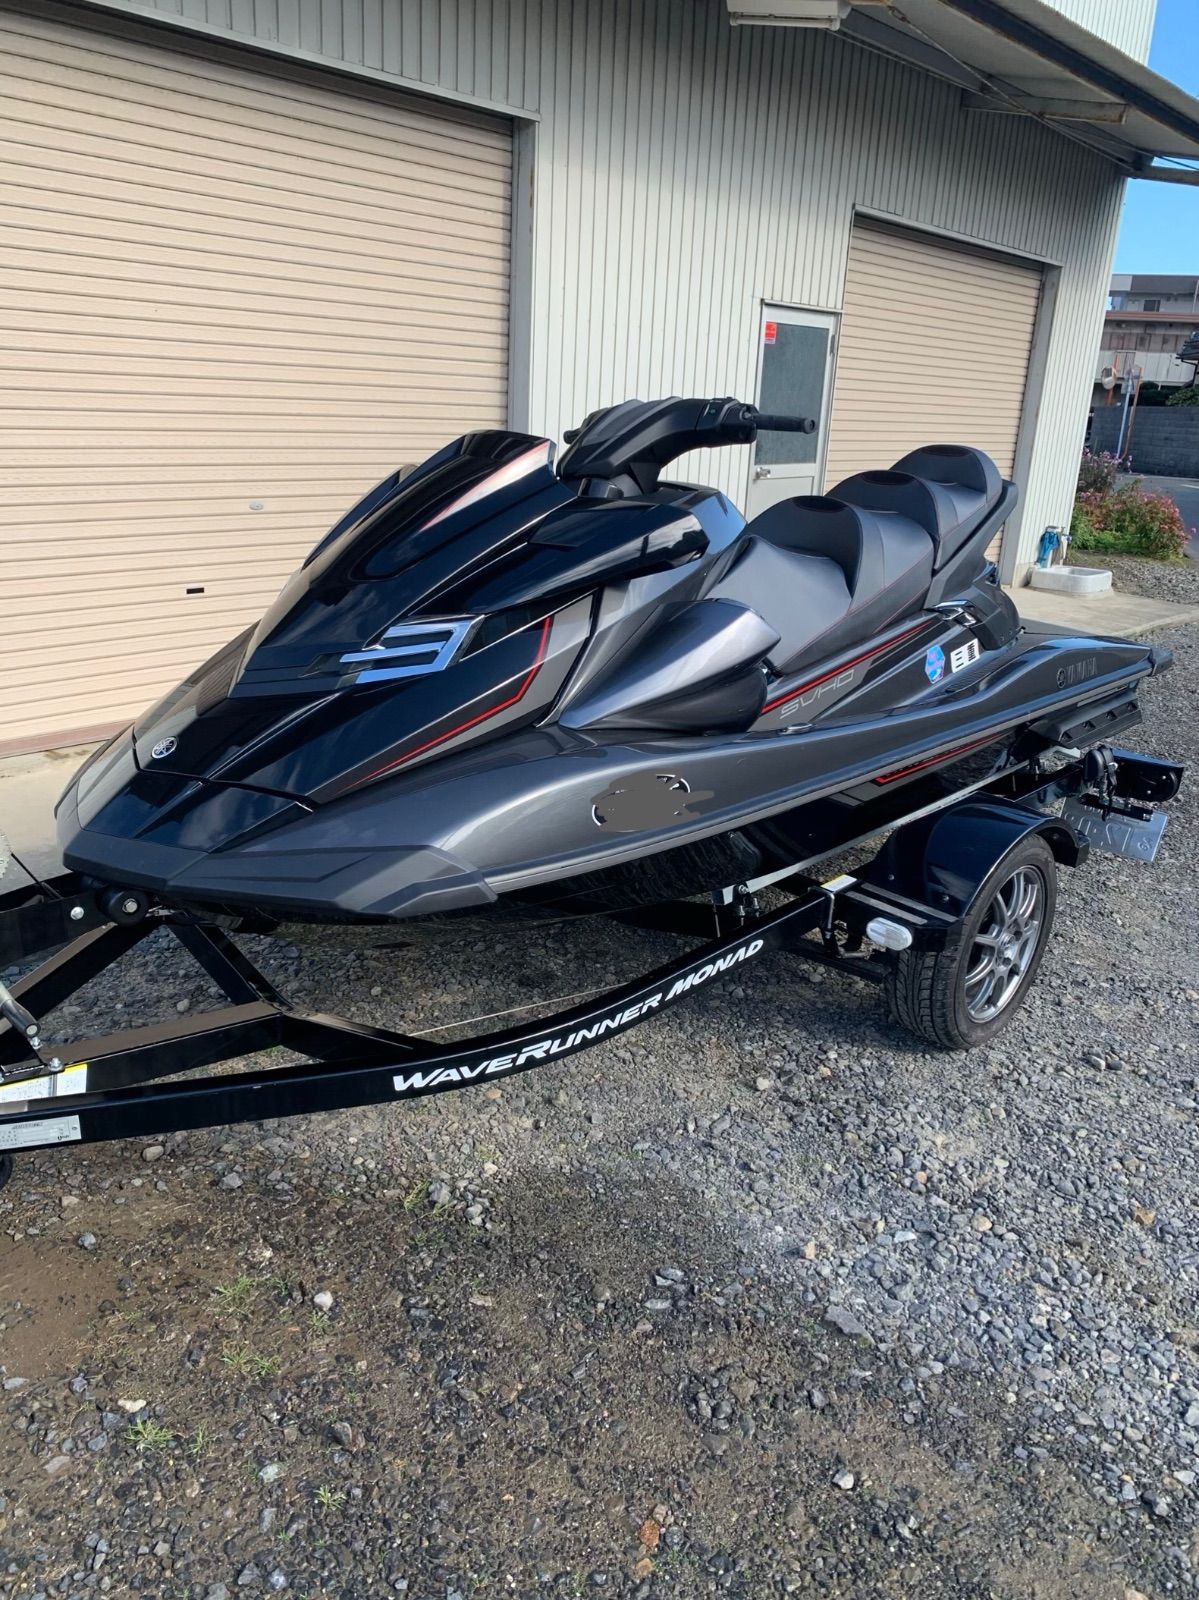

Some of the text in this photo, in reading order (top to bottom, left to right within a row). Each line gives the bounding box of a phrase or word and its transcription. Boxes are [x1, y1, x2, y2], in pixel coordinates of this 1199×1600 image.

[780, 669, 855, 719] SVHO
[393, 939, 764, 1091] WAVERUNNER MONAD
